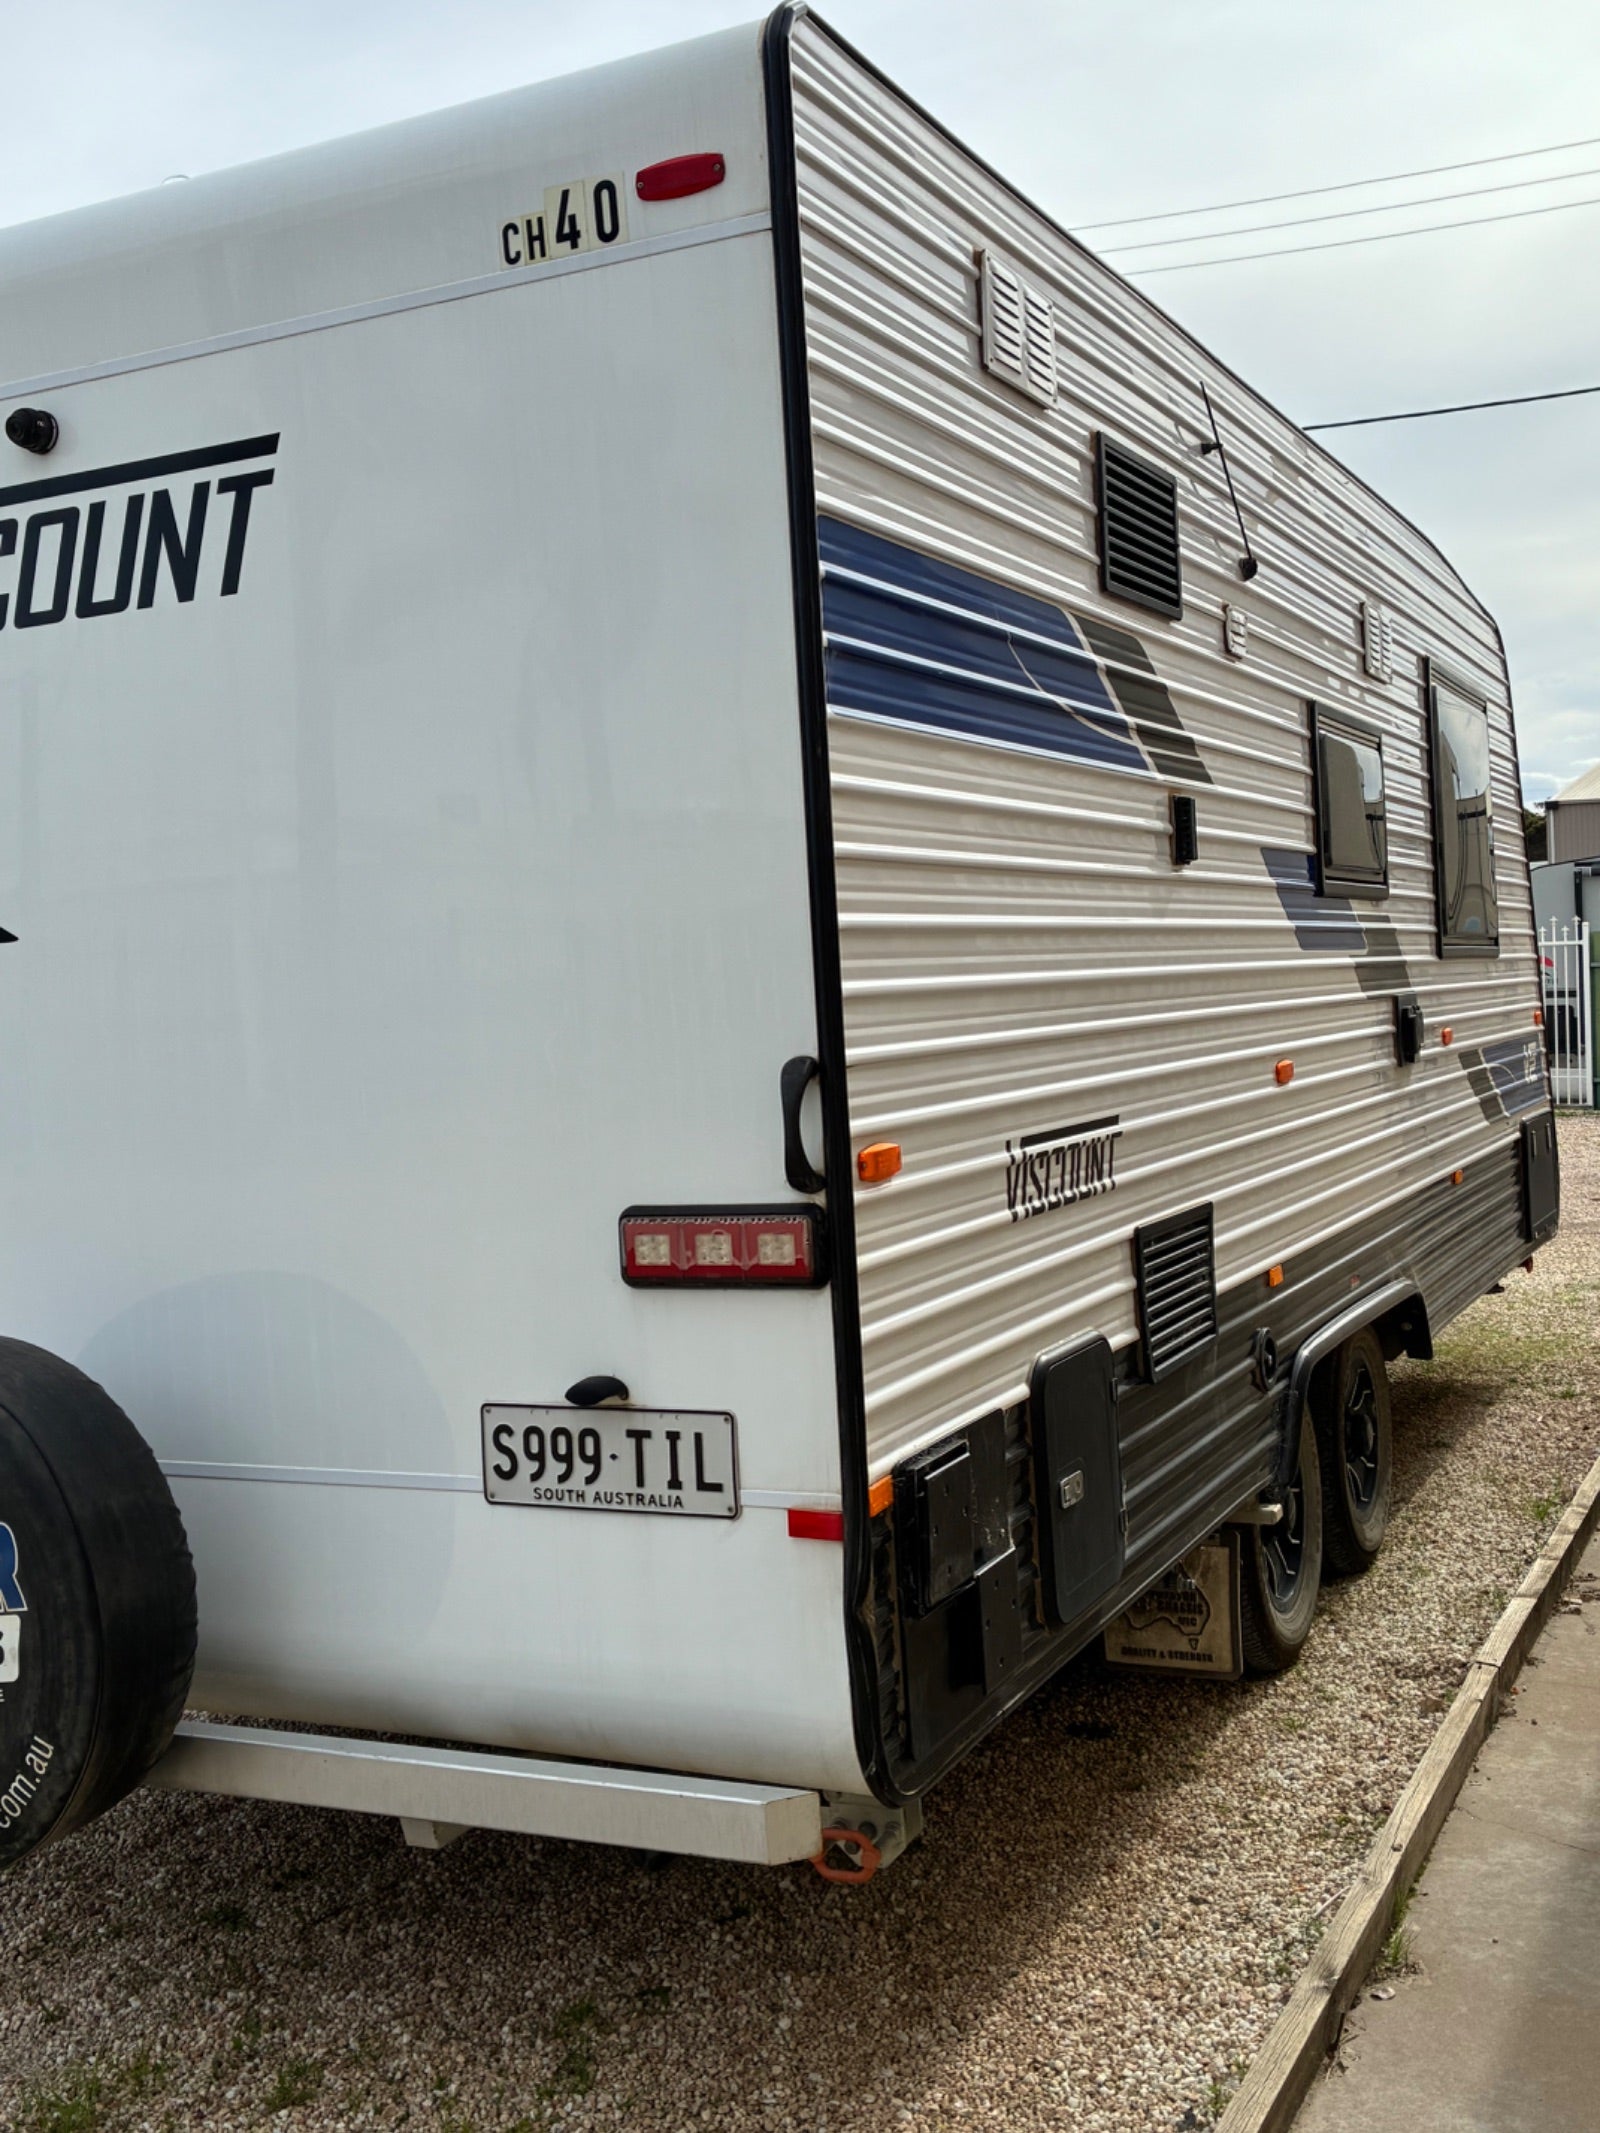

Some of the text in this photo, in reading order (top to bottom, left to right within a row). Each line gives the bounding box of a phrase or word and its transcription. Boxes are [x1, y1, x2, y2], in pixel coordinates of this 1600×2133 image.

[1006, 1131, 1123, 1223] VISCOUNT
[533, 1487, 684, 1509] SOUTH AUSTRALIA
[1120, 1646, 1214, 1663] QUALITY & STRENGTH
